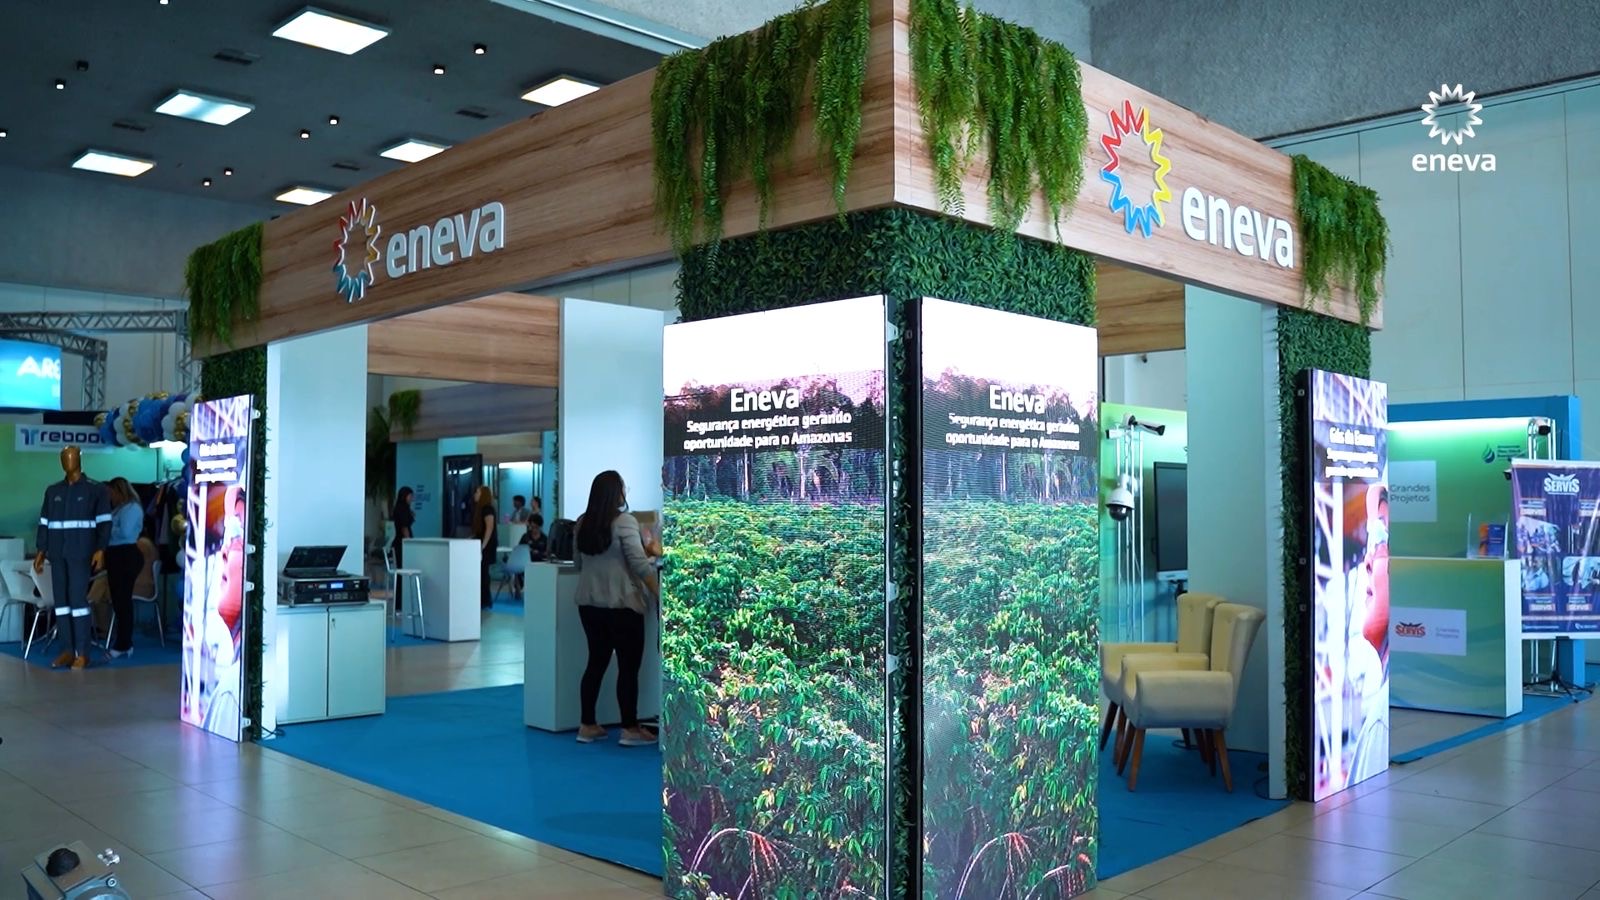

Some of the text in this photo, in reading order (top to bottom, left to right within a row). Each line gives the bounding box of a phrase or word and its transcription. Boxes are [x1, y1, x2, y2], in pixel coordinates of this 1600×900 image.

[1181, 186, 1294, 269] eneva
[386, 201, 505, 279] eneva
[730, 388, 800, 413] Eneva
[989, 384, 1046, 414] Eneva
[686, 410, 852, 435] Segurança energética gerando
[948, 412, 999, 430] Segurança
[999, 417, 1046, 433] energética
[683, 430, 853, 452] oportunidade para o Amazonas
[945, 432, 1010, 447] oportunidade
[1010, 436, 1031, 449] para
[1031, 438, 1039, 448] o
[1389, 483, 1431, 493] Grandes
[1543, 477, 1580, 493] SERVIS
[1390, 494, 1431, 504] Projetos
